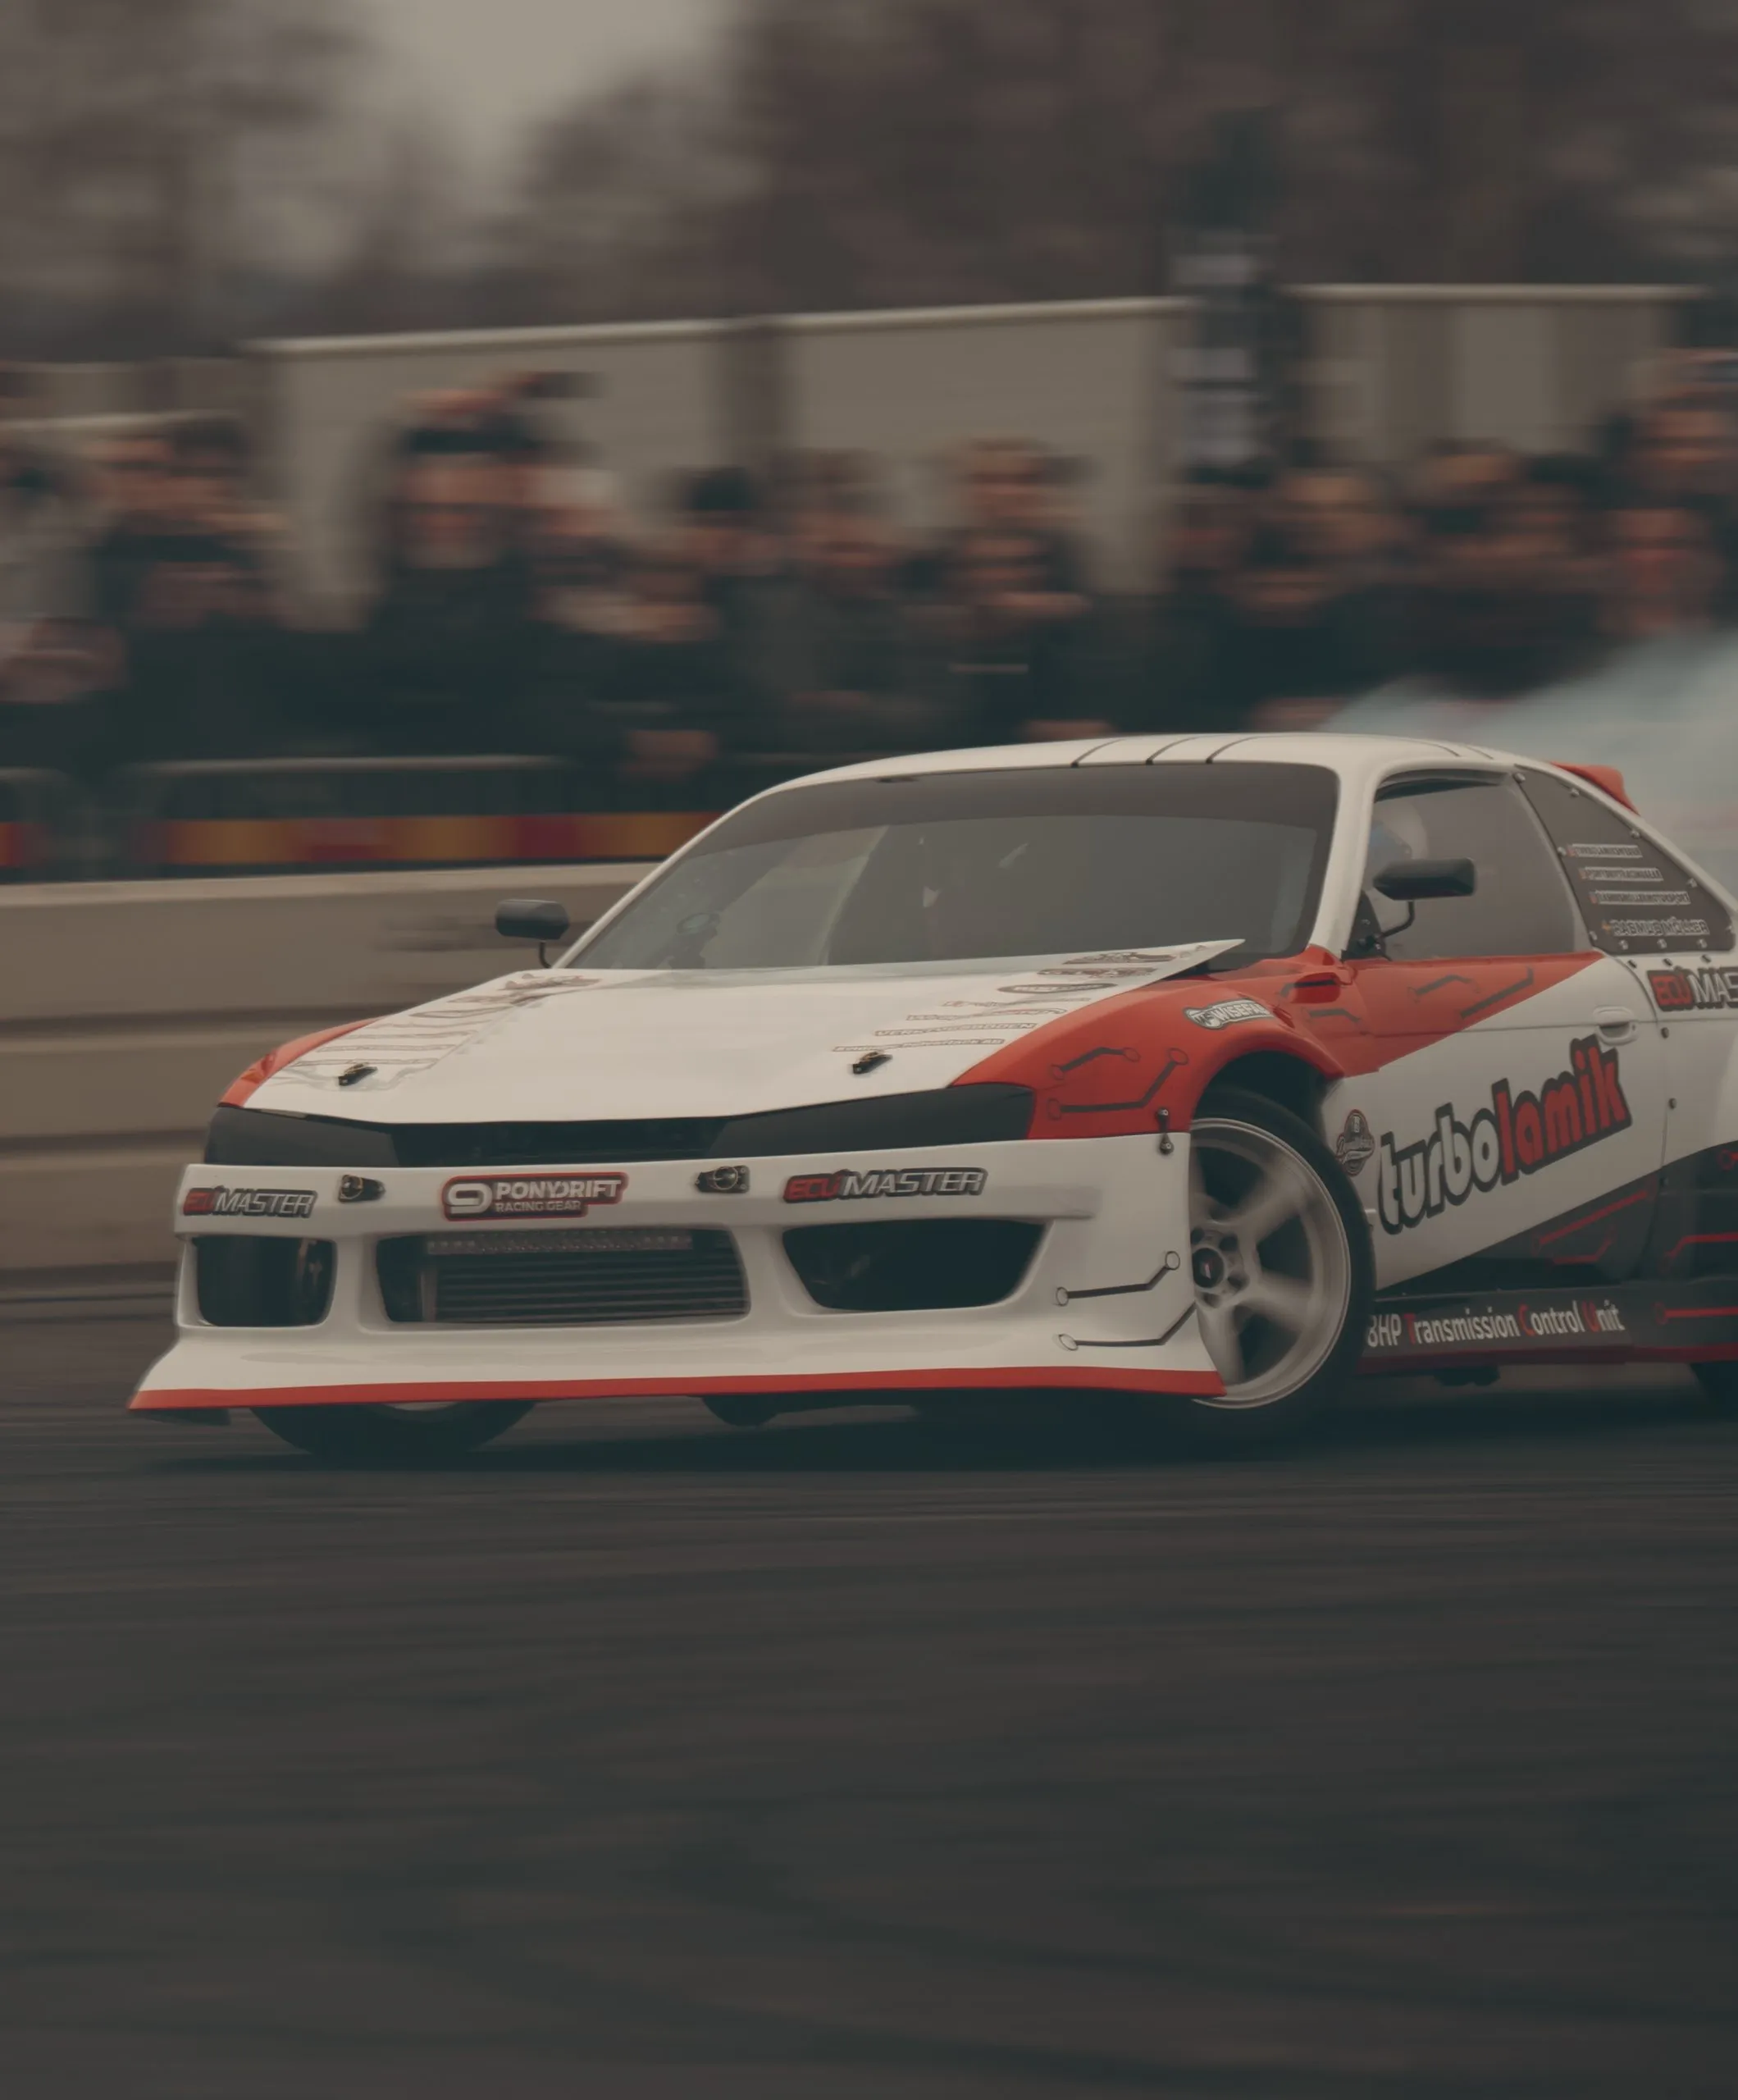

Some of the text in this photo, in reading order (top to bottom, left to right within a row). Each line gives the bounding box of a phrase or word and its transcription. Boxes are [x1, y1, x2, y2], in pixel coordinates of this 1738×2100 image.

[1379, 1039, 1630, 1231] turbolamik
[495, 1179, 622, 1200] PONYDRIFT
[495, 1200, 582, 1213] RACING GEAR
[1403, 1306, 1521, 1344] Transmission
[1518, 1300, 1585, 1336] Control
[1581, 1299, 1626, 1331] Unit
